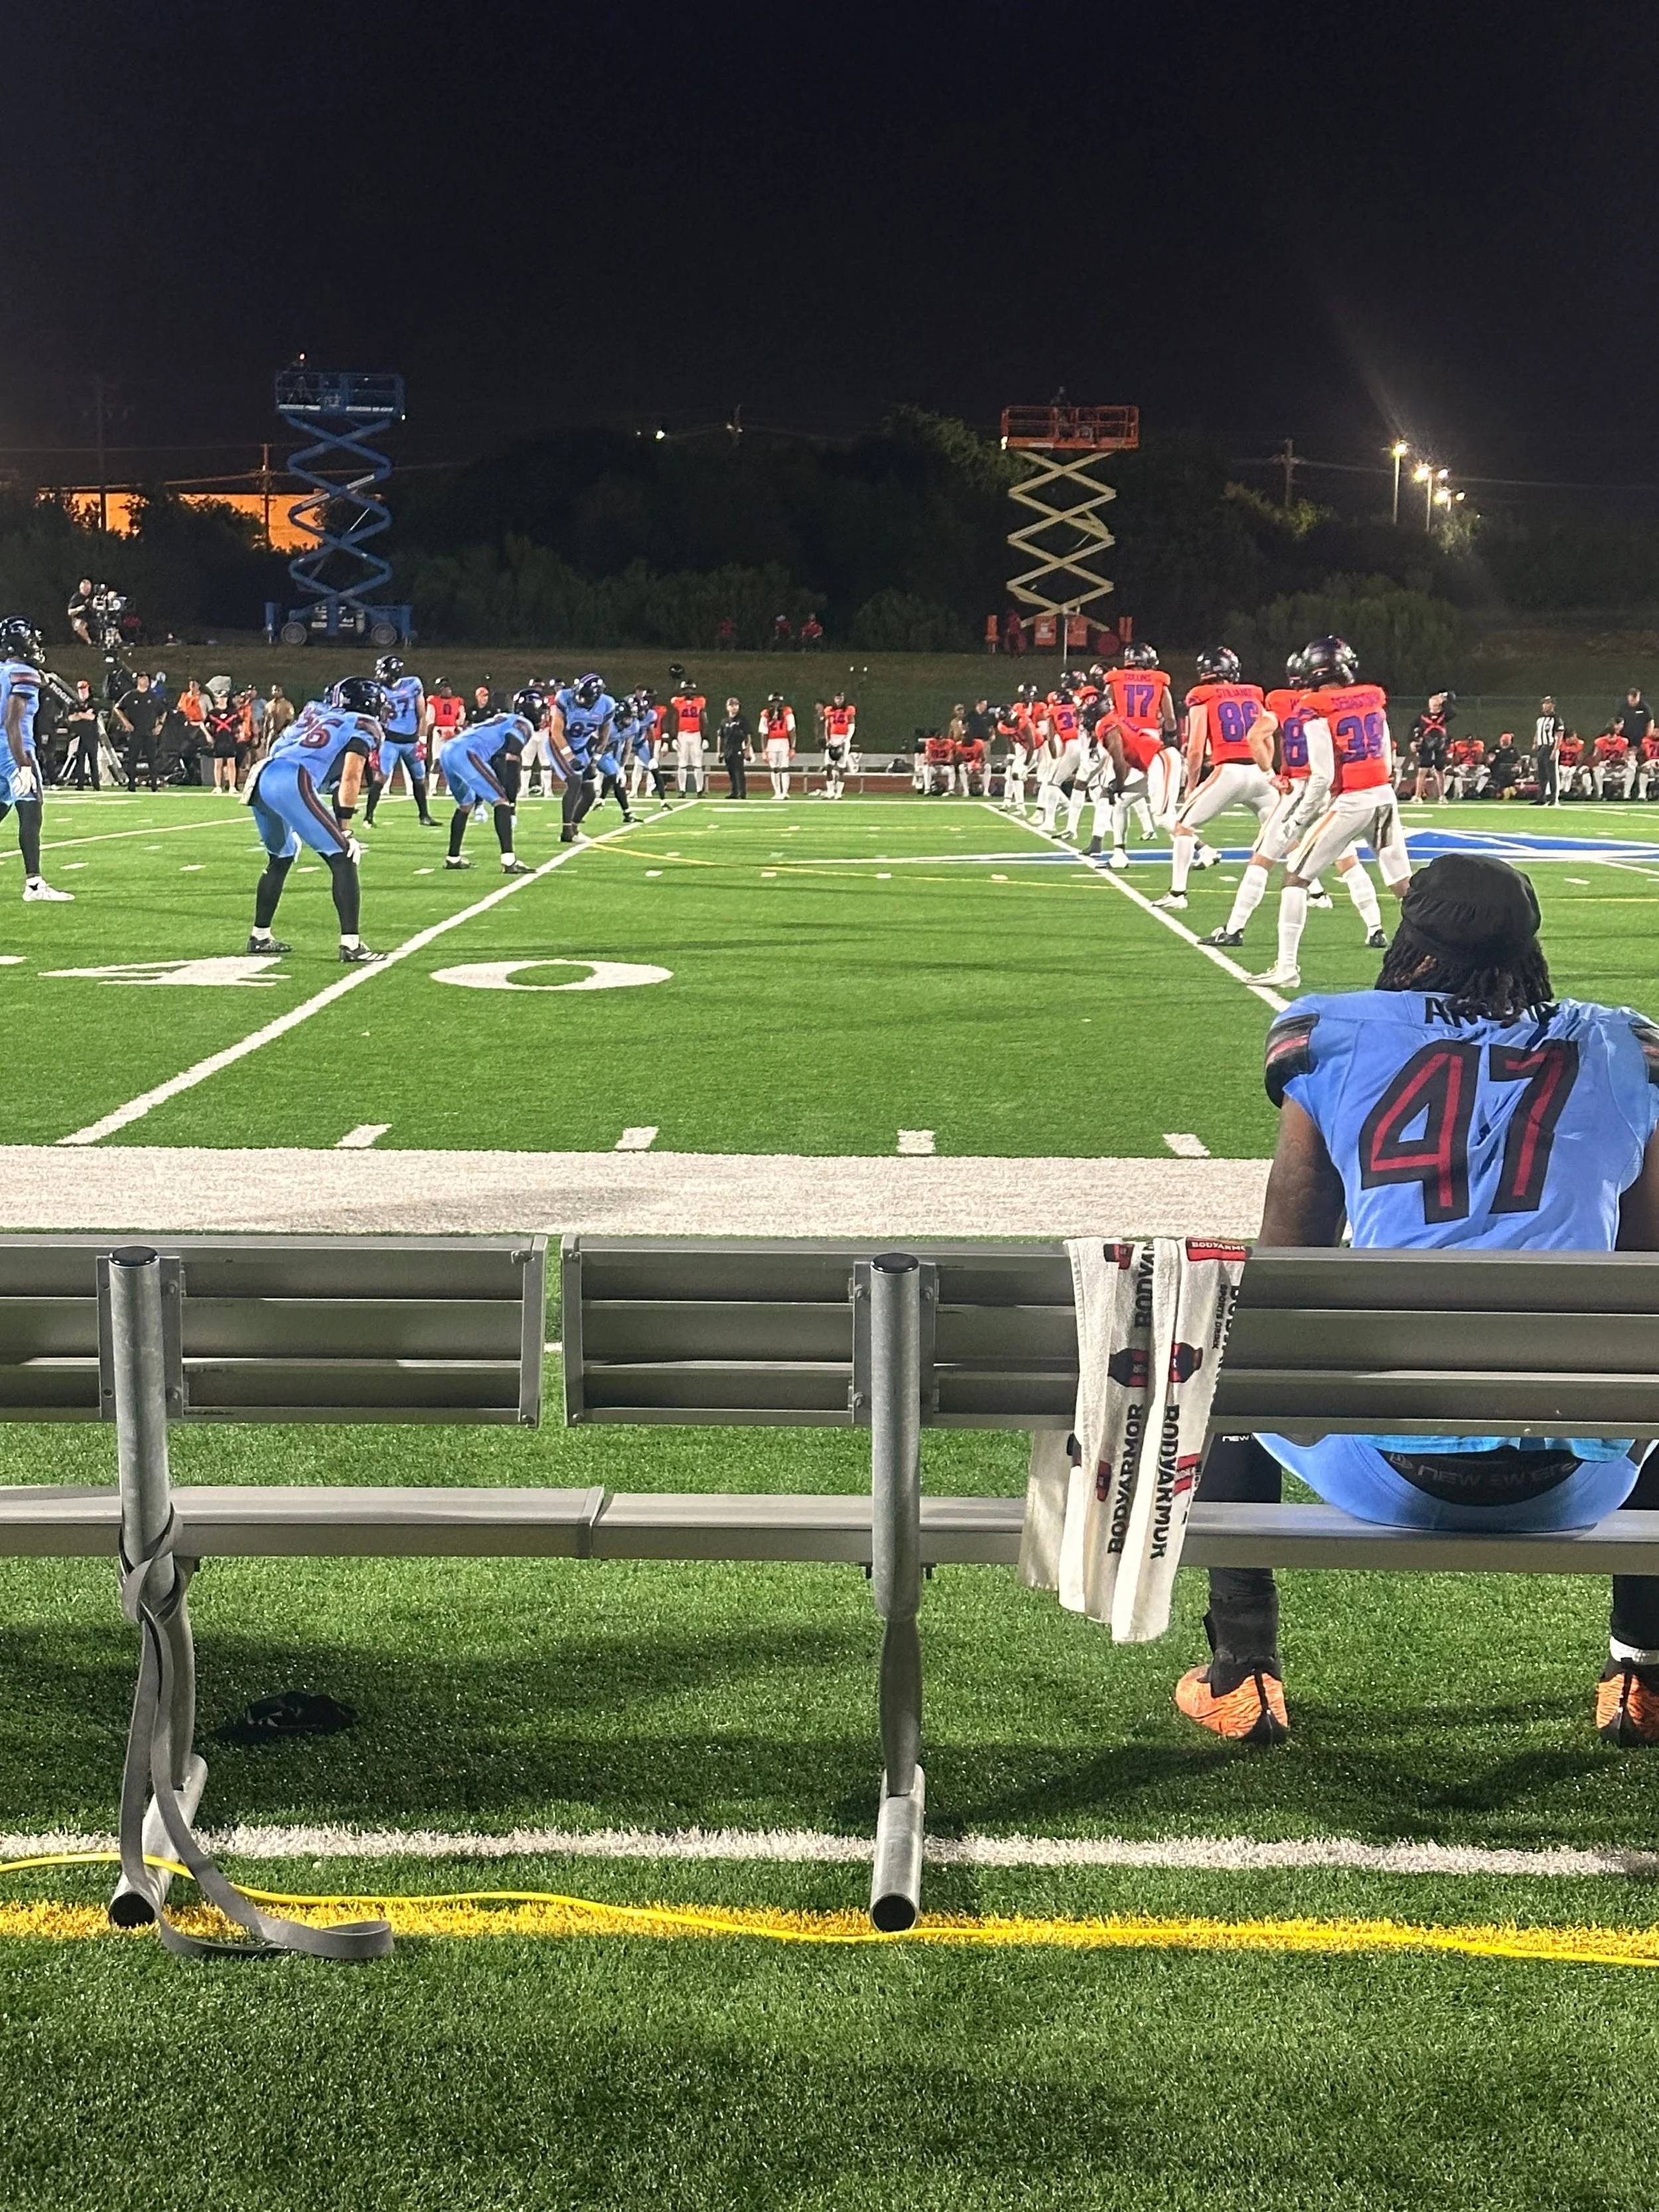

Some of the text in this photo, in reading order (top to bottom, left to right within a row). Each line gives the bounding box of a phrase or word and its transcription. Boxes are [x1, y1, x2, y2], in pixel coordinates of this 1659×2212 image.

[1058, 711, 1078, 731] 3
[1123, 684, 1155, 717] 17
[1218, 701, 1259, 743] 86
[1283, 717, 1309, 767] 8
[1336, 712, 1384, 763] 39
[1358, 1039, 1579, 1225] 47
[1212, 1321, 1222, 1349] DRINK
[1108, 1403, 1143, 1554] BODYARMOR
